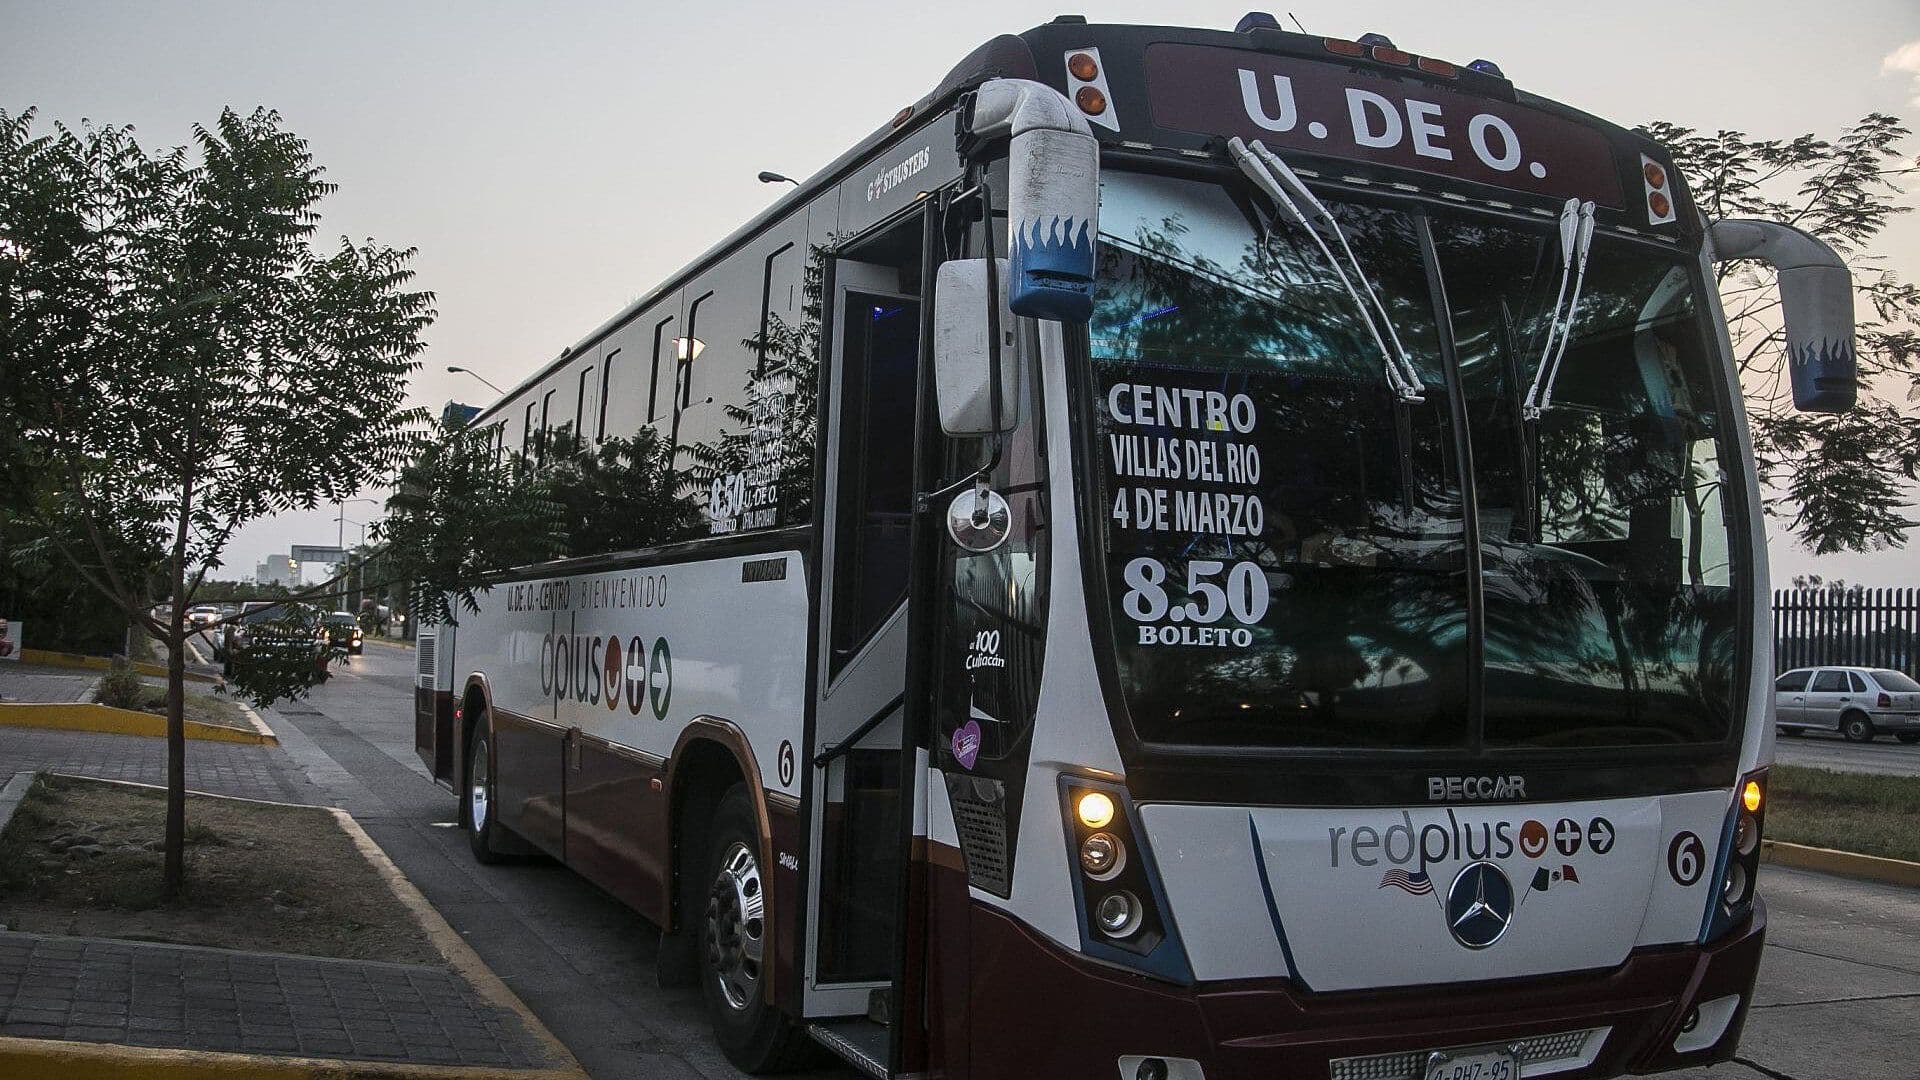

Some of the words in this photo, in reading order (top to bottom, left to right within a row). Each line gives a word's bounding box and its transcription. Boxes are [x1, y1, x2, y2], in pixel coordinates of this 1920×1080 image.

[1237, 68, 1328, 139] U.
[1345, 87, 1453, 161] DE
[1468, 113, 1548, 179] O.
[1108, 383, 1256, 434] CENTRO
[1110, 434, 1181, 479] VILLAS
[1186, 440, 1223, 482] DEL
[1226, 443, 1260, 485] RIO
[709, 473, 744, 520] 8.50
[1113, 487, 1129, 529] 4
[1135, 487, 1169, 531] DE
[1175, 491, 1263, 537] MARZO
[581, 574, 668, 609] BIENVENIDO
[1123, 557, 1270, 624] 8.50
[966, 652, 1005, 670] Culiacán
[975, 629, 1000, 655] 100
[1138, 625, 1253, 648] BOLETO
[1428, 775, 1527, 800] BECCAR
[1328, 808, 1513, 872] redplus
[1674, 833, 1699, 883] 6
